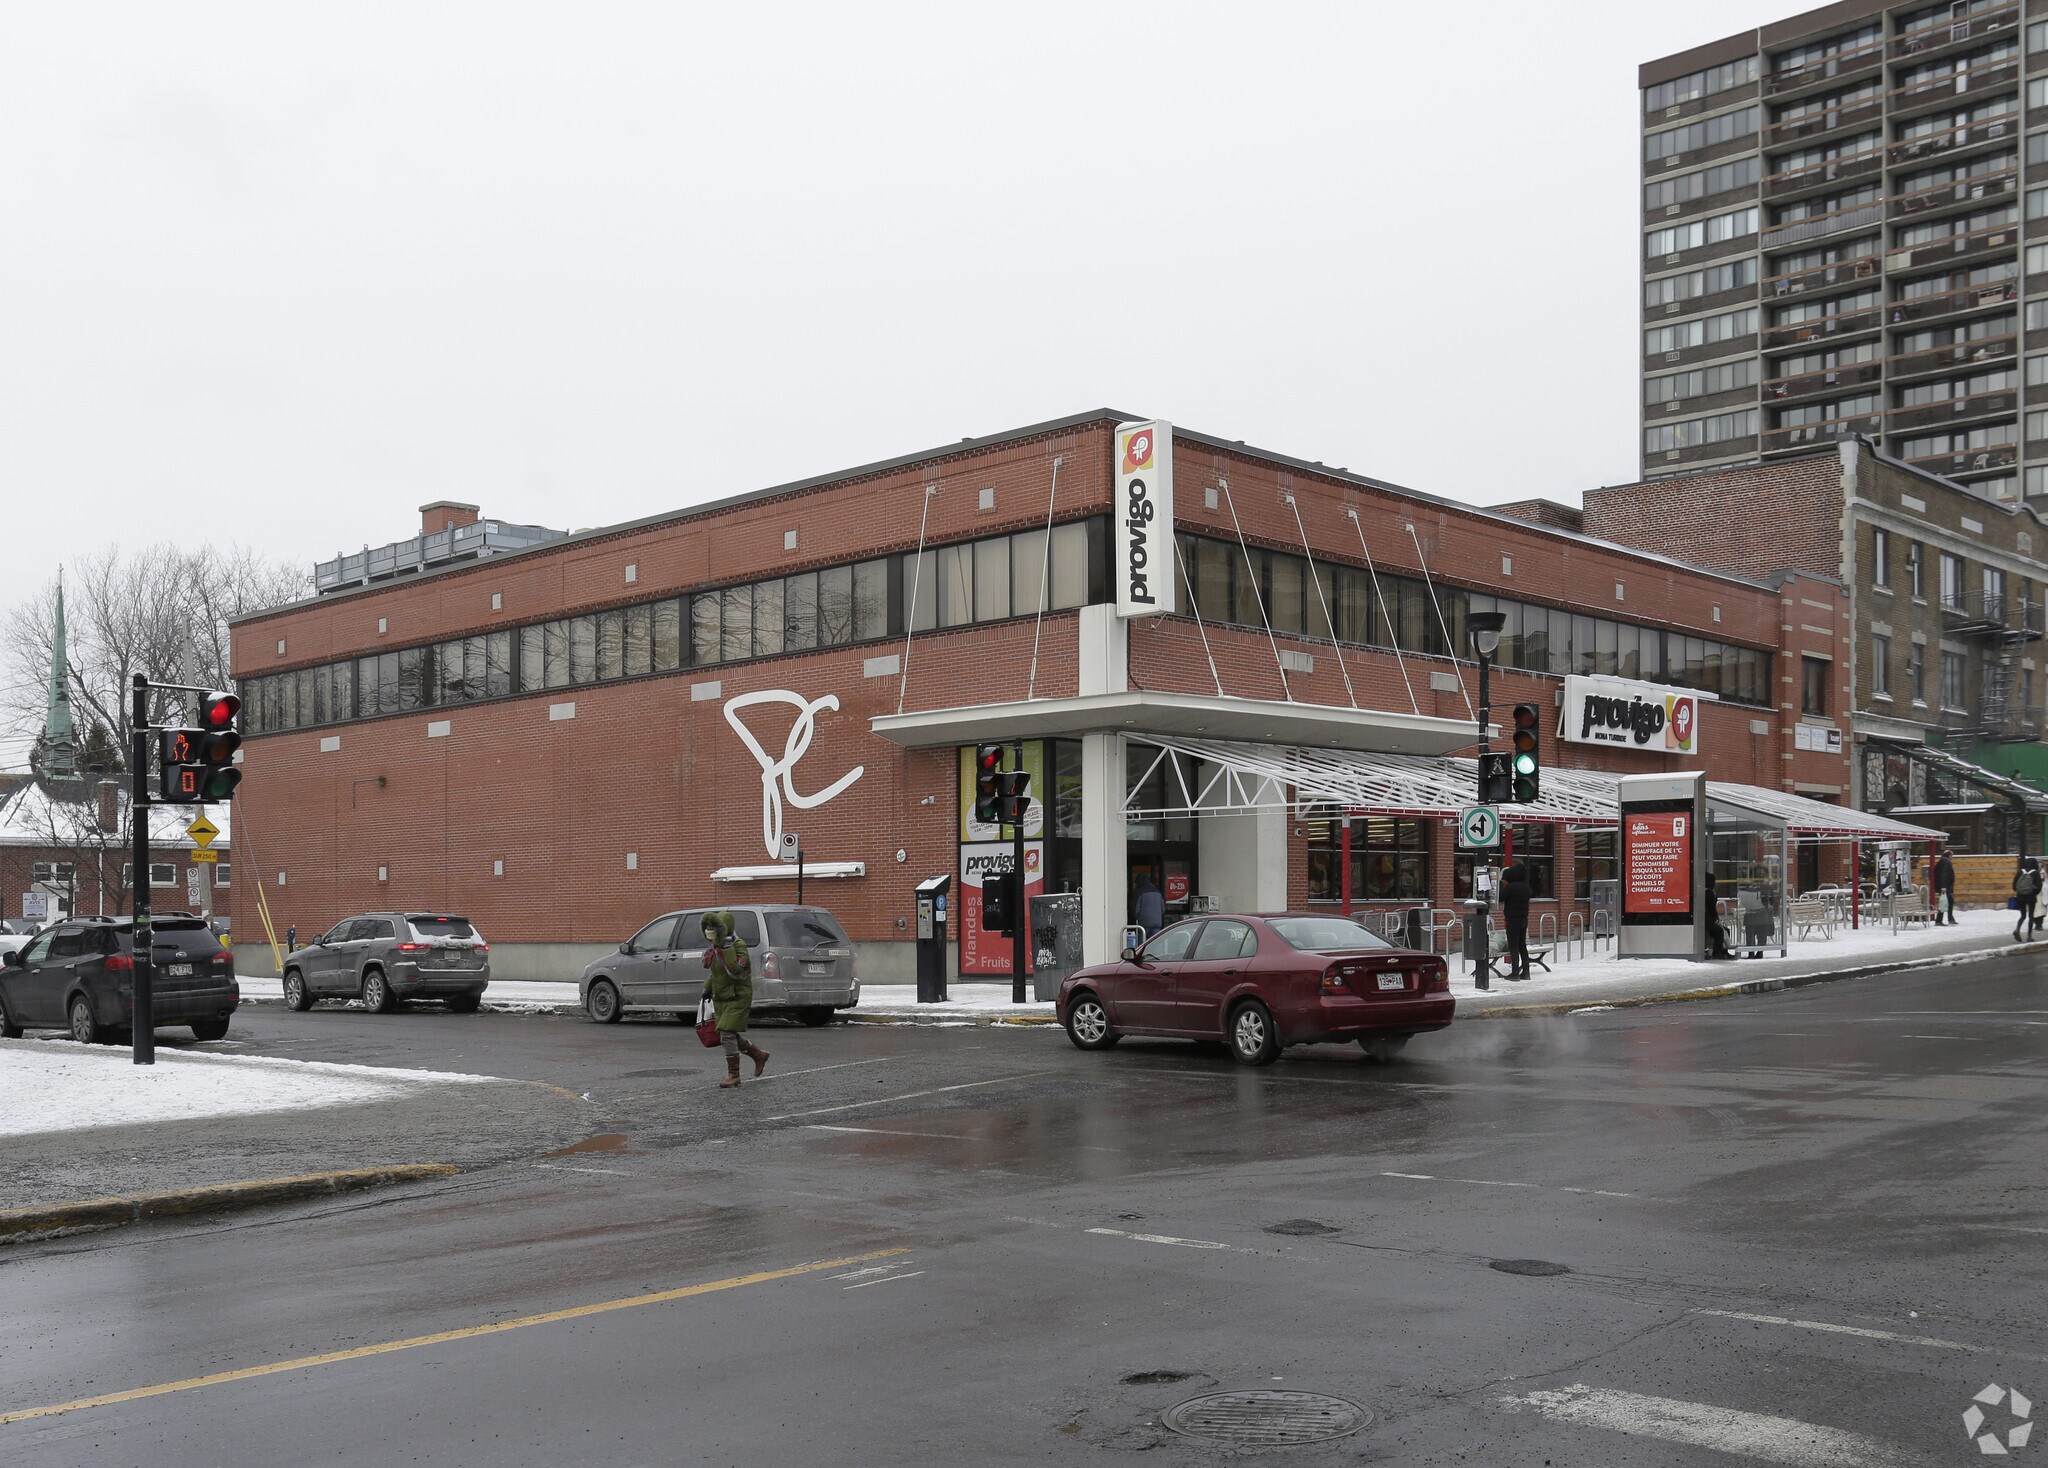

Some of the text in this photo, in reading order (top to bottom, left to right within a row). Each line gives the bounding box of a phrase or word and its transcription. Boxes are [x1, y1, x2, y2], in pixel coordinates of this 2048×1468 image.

[1126, 478, 1155, 604] provigo
[1581, 694, 1665, 744] provigo
[965, 896, 977, 967] Viandes
[981, 956, 1011, 968] Fruits
